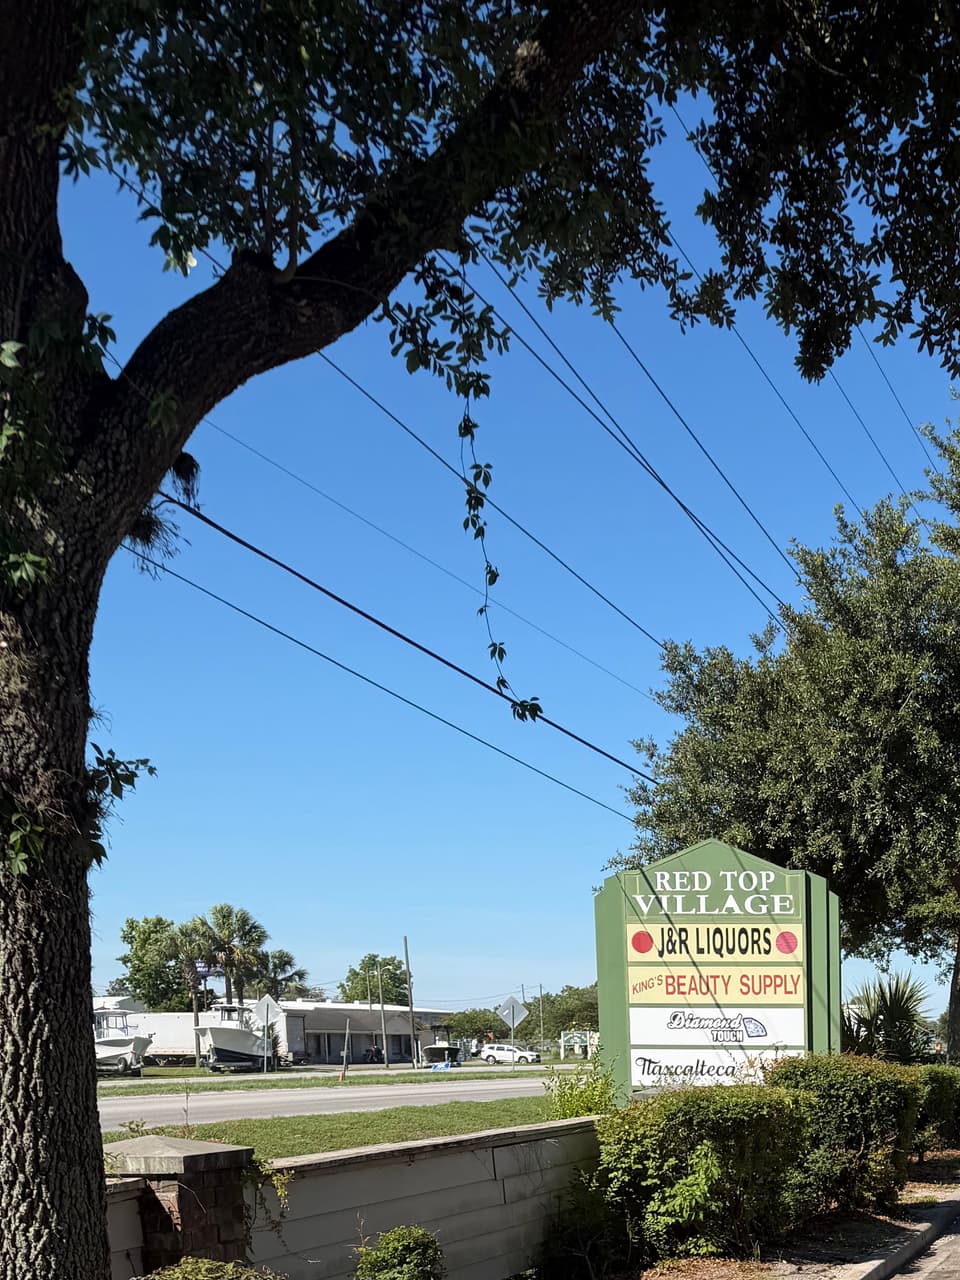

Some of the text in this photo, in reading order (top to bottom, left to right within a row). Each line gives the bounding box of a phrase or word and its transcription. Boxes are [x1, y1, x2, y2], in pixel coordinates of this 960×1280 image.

[654, 871, 775, 891] RED TOP
[633, 894, 794, 915] VILLAGE
[657, 927, 772, 957] J&R LIQUORS
[632, 974, 801, 996] KING'S BEAUTY SUPPLY
[667, 1011, 742, 1029] Diamond
[711, 1030, 744, 1042] TOUCH
